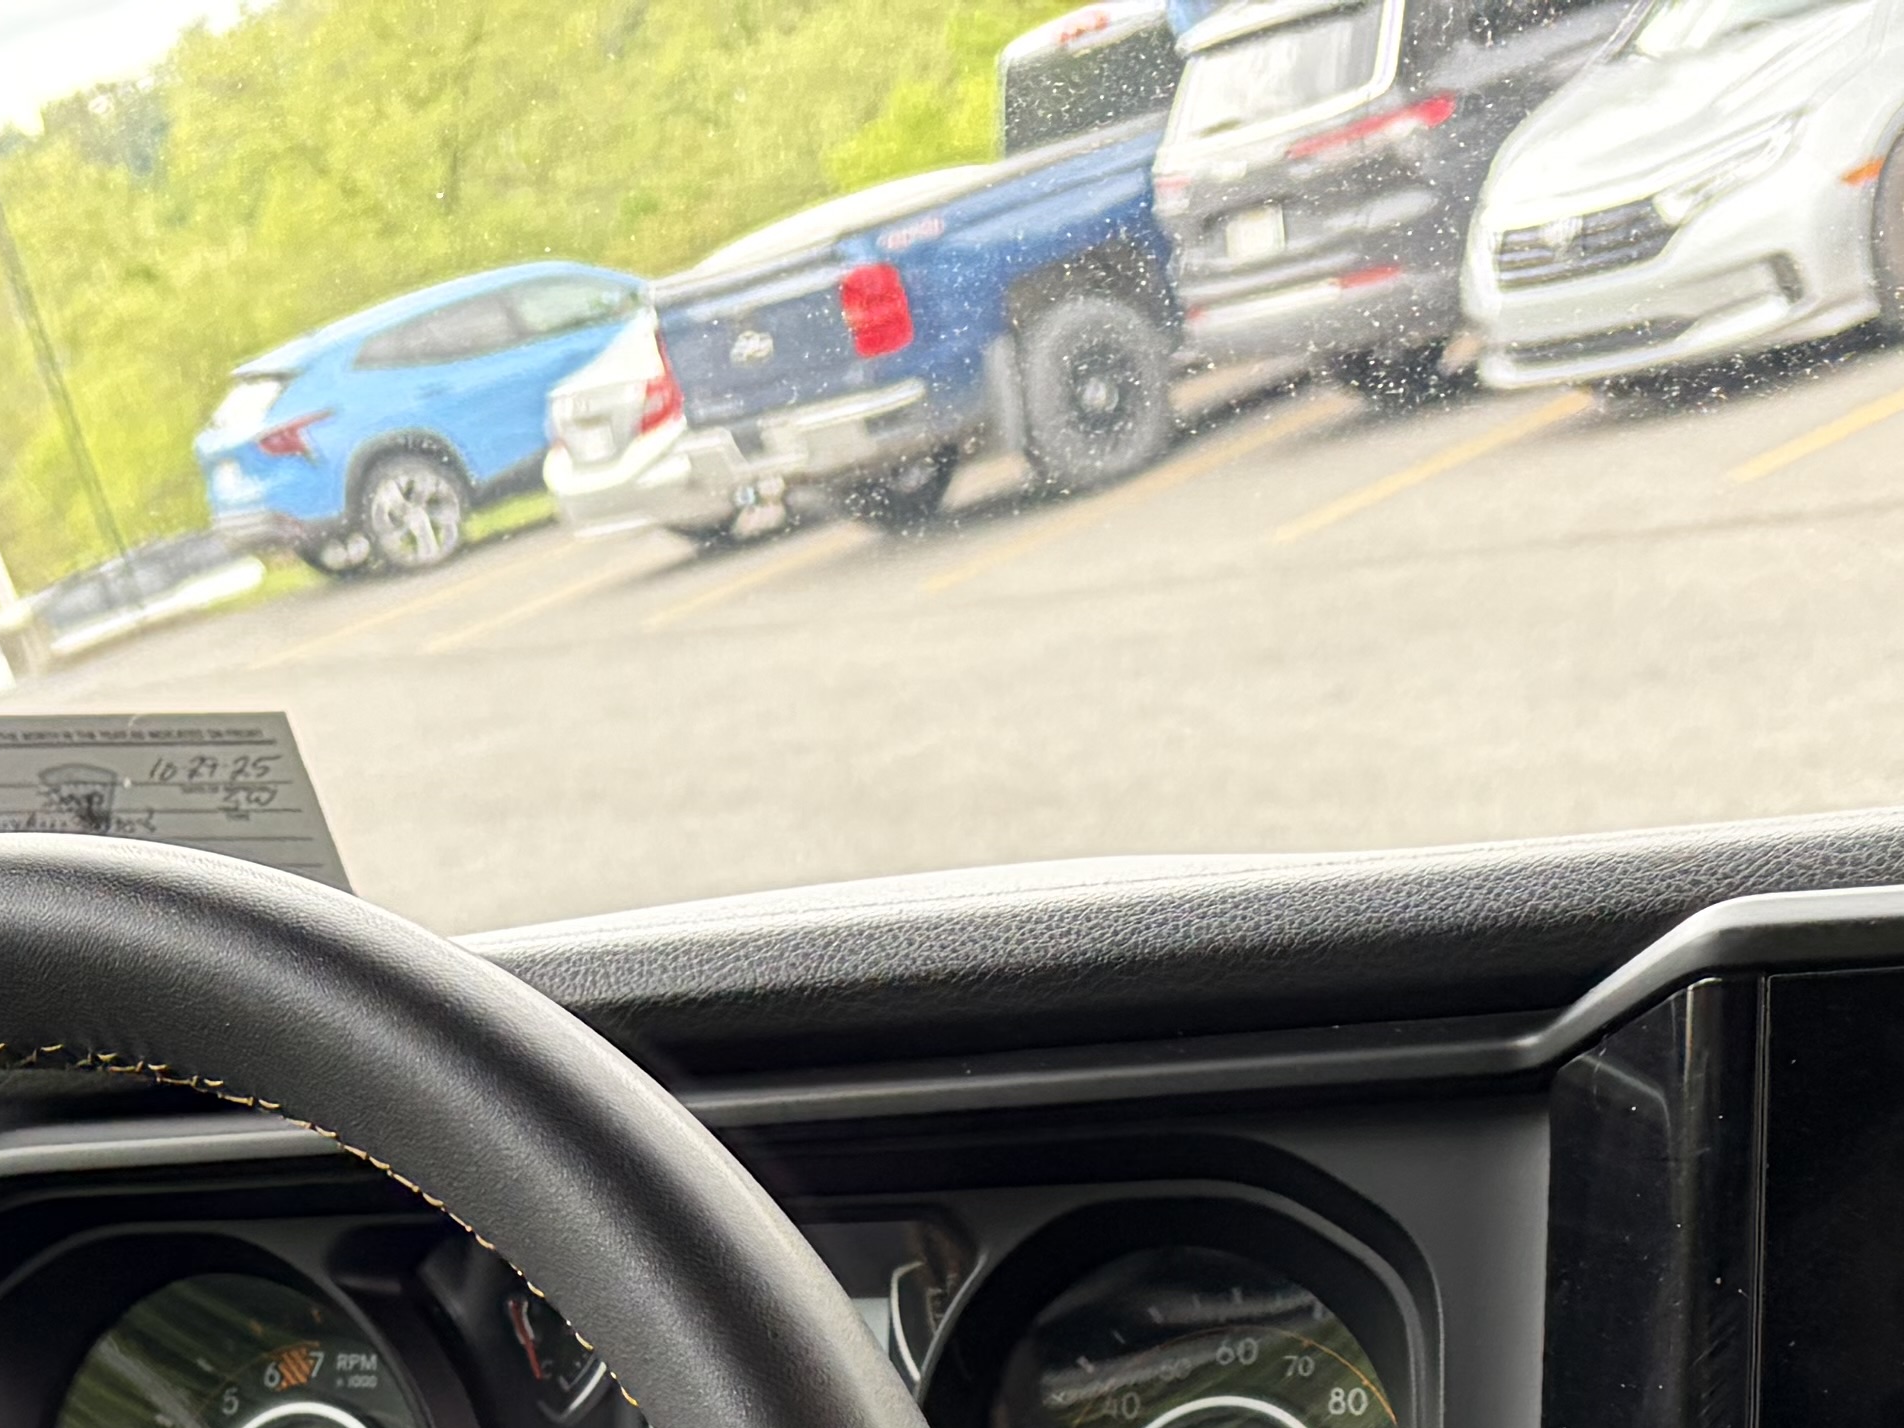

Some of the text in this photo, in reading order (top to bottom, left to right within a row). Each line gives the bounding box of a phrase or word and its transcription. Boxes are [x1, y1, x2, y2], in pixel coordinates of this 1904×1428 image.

[336, 1352, 379, 1371] RPM
[1215, 1338, 1259, 1367] 60
[263, 1361, 281, 1388] 6
[1285, 1354, 1315, 1379] 70
[1327, 1388, 1370, 1417] 80
